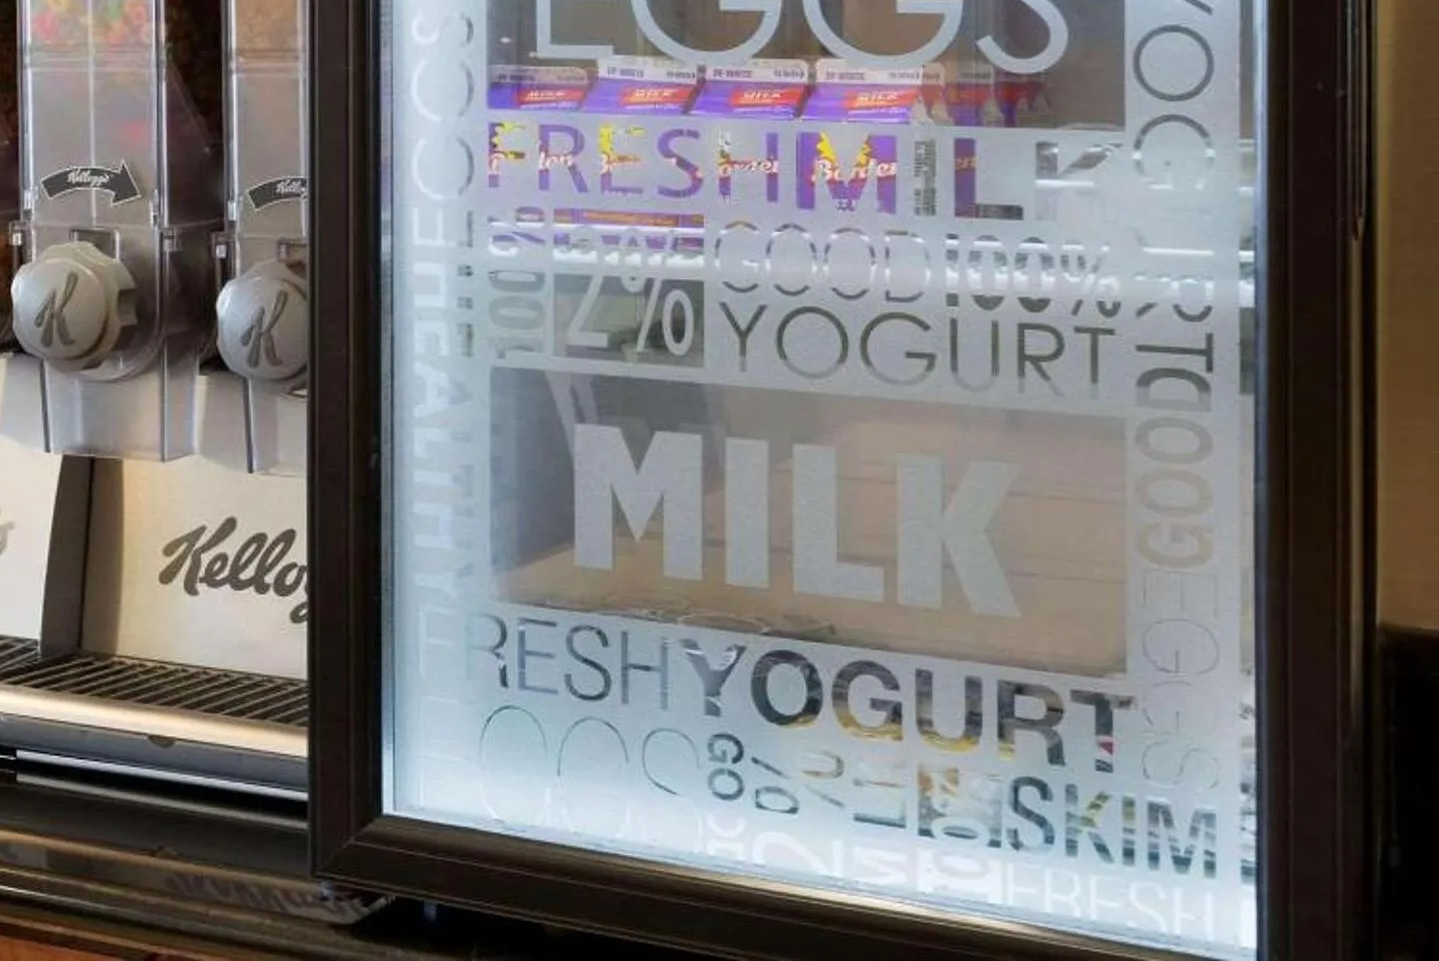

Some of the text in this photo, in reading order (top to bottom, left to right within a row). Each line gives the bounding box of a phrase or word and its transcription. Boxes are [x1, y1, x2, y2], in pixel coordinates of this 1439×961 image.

[68, 167, 110, 187] Kellogg's
[488, 120, 1124, 221] FRESH MILK
[719, 301, 1117, 400] YOGURT
[158, 515, 307, 624] Kello
[574, 422, 1022, 618] MILK
[675, 636, 1139, 774] YOGURT
[1008, 775, 1218, 880] SKIM
